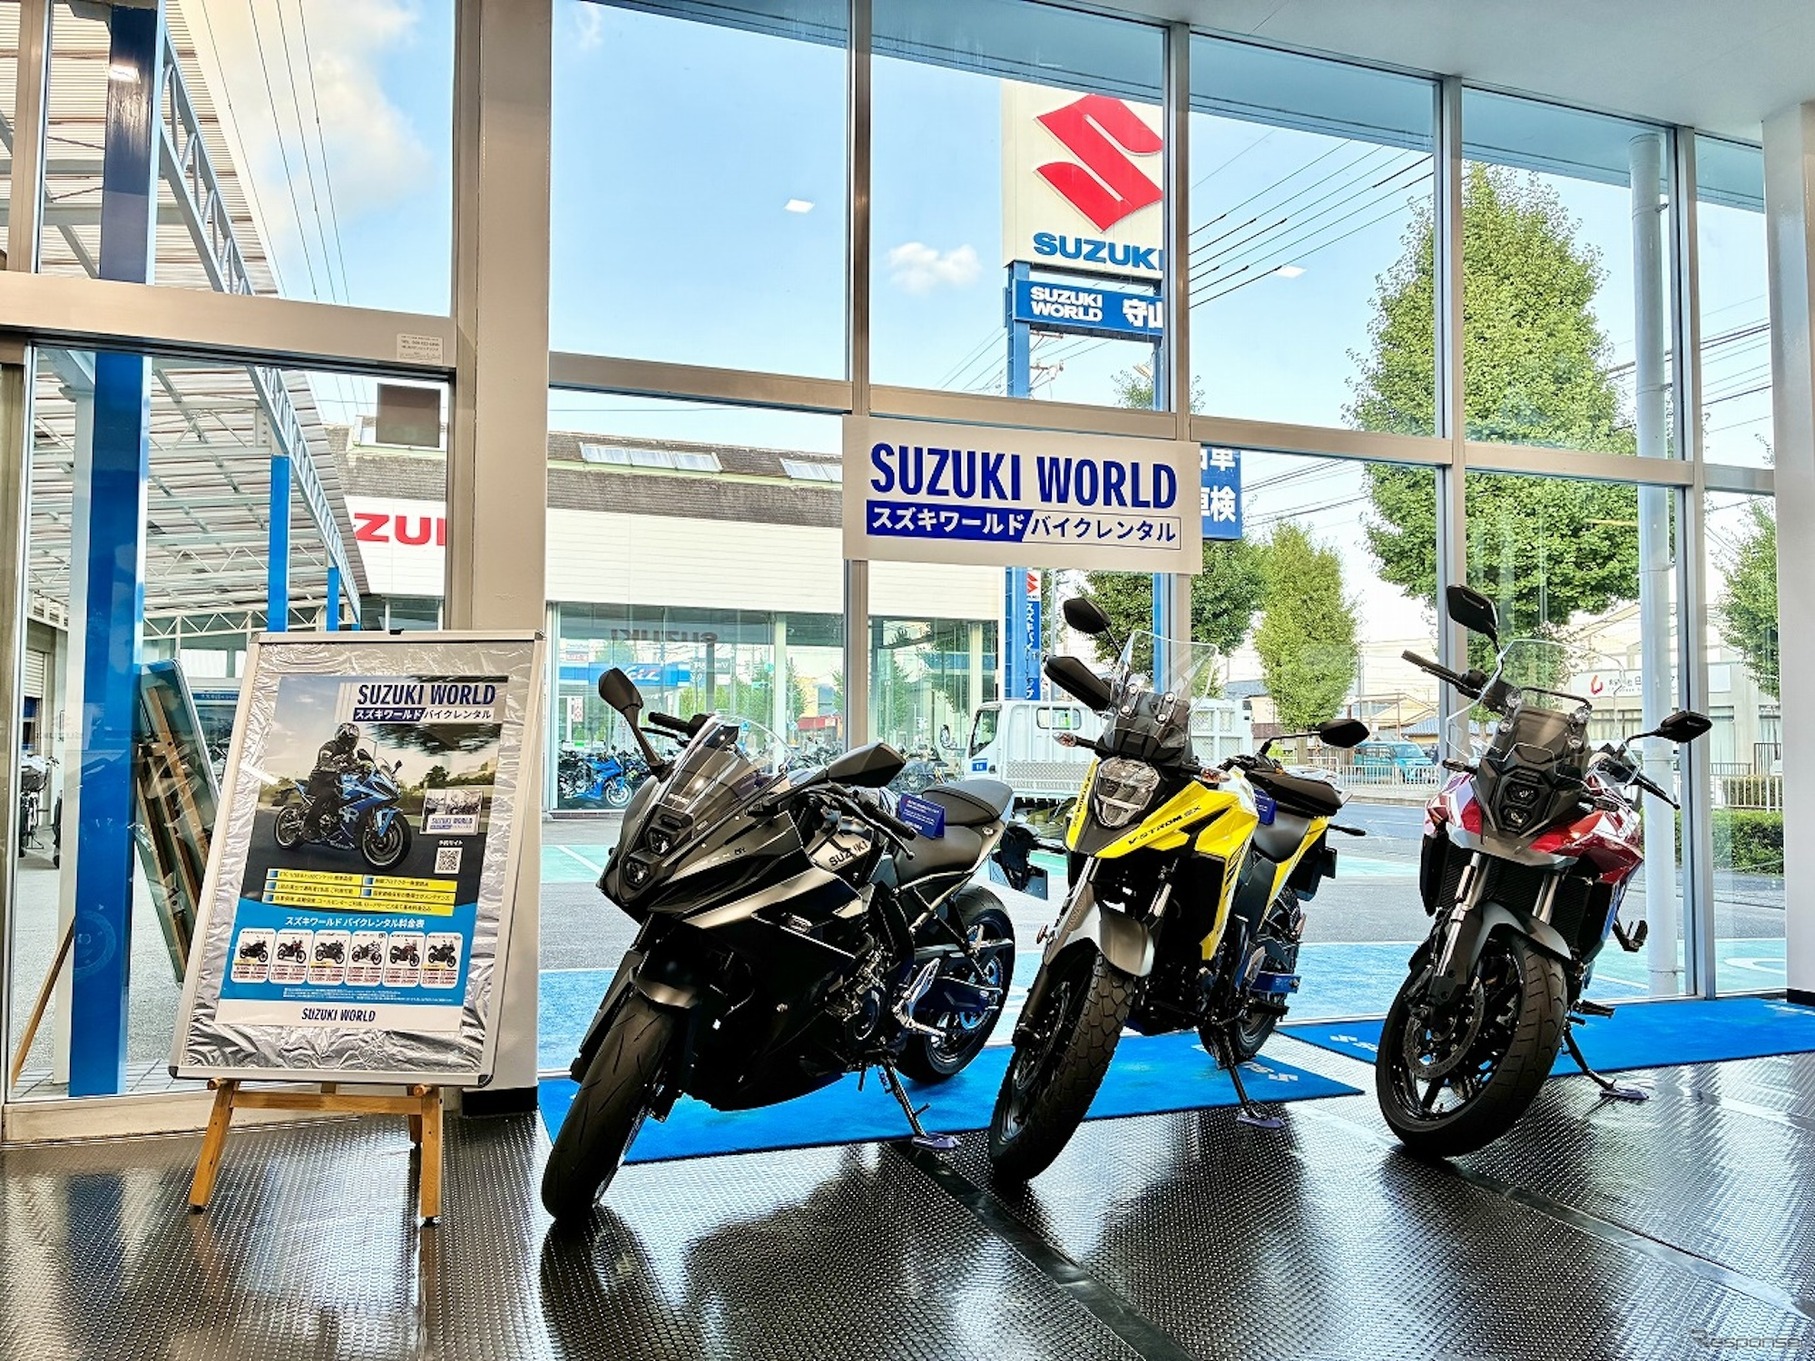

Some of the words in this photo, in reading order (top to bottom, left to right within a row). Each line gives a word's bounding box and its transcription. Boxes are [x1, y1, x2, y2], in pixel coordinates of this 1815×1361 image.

[1031, 286, 1102, 308] SUZUKI
[1031, 302, 1102, 322] WORLD
[870, 442, 1021, 501] SUZUKI
[1036, 456, 1177, 509] WORLD
[871, 505, 1024, 537] スズキワールド
[1030, 517, 1176, 542] バイクレンタル
[357, 684, 424, 705] SUZUKI
[430, 684, 496, 705] WORLD
[355, 709, 422, 720] スズキワールド
[424, 709, 491, 720] バイクレンタル
[301, 1006, 337, 1022] SUZUKI
[340, 1009, 376, 1022] WORLD
